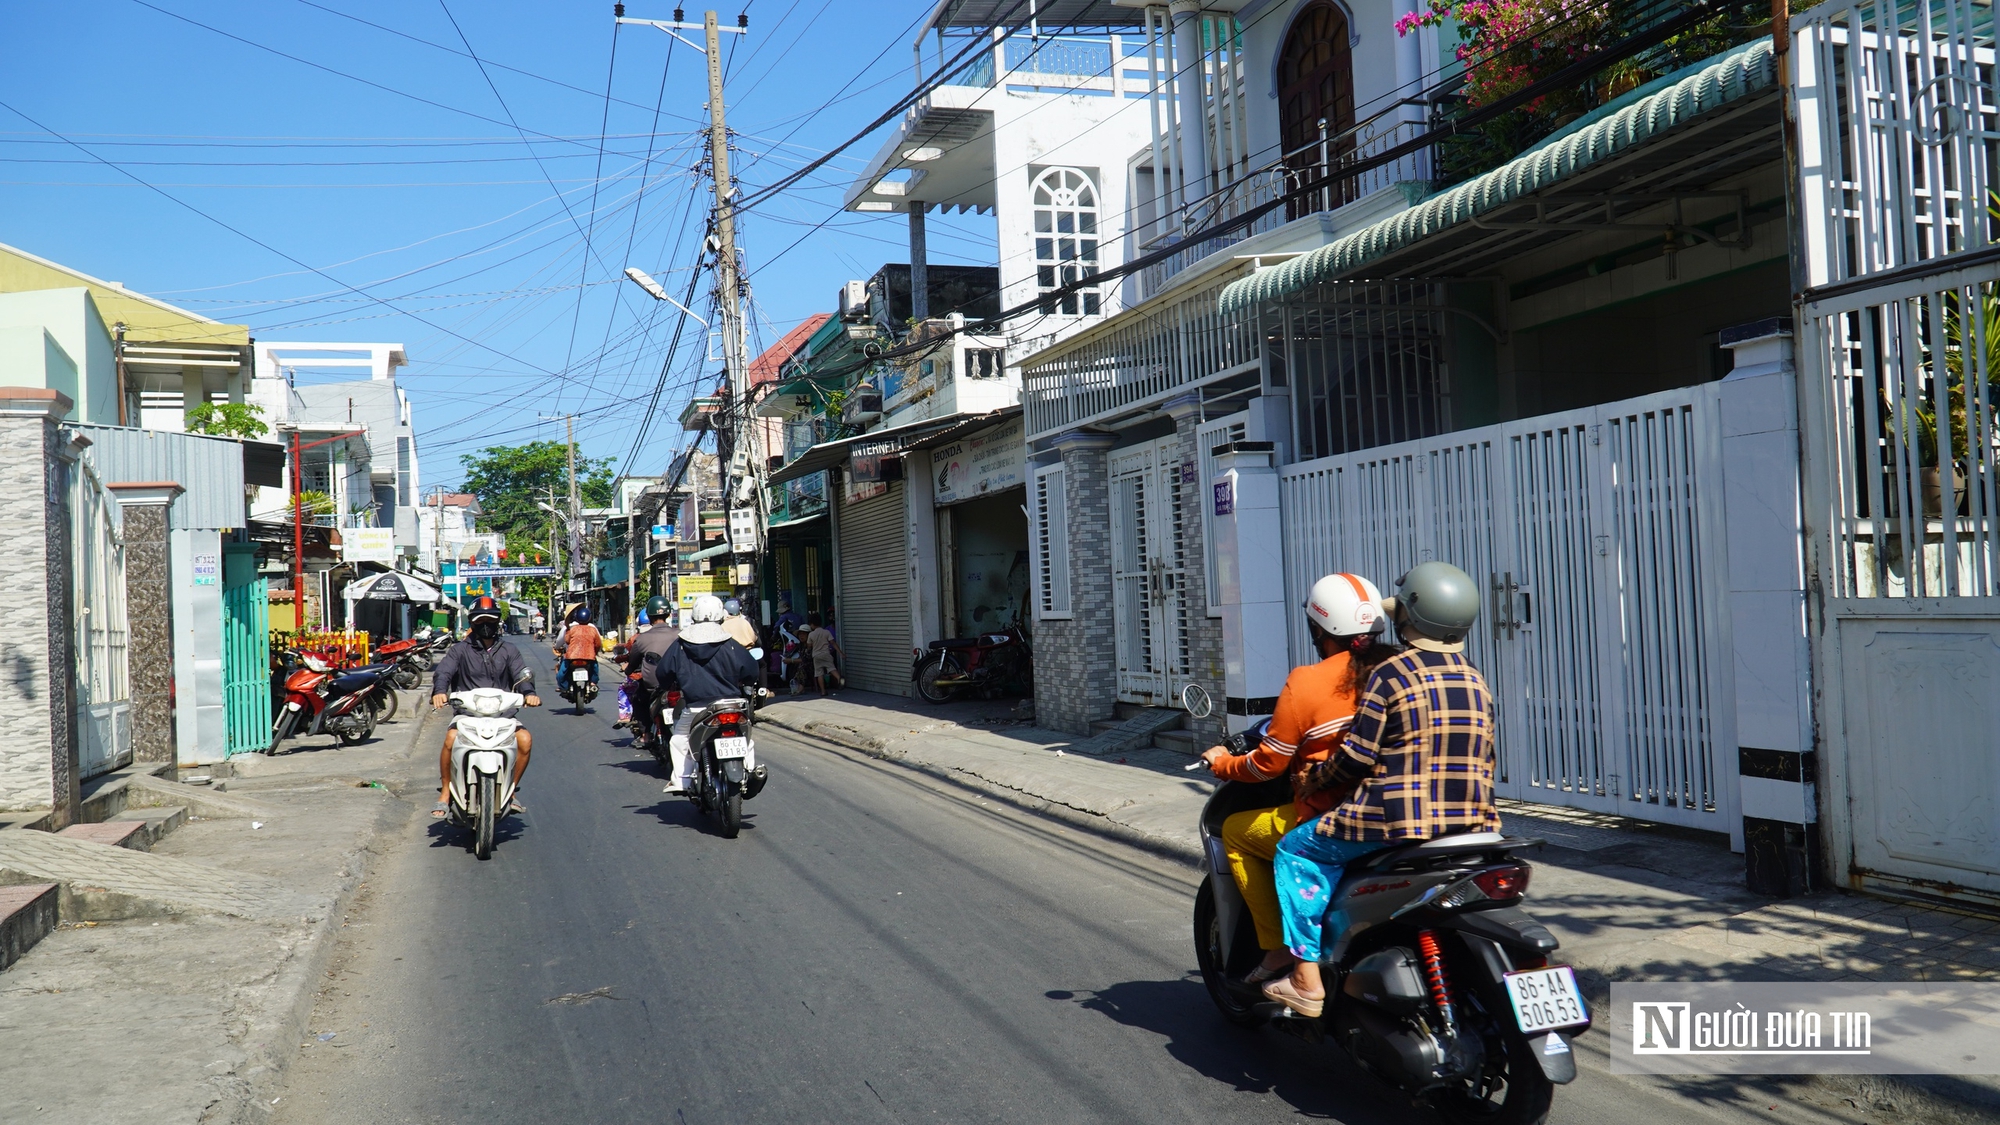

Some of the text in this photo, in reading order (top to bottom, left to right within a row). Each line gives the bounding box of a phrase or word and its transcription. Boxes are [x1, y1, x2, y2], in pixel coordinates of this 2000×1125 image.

[852, 440, 895, 457] INTERNET
[933, 443, 963, 463] HONDA
[1216, 485, 1230, 503] 39B
[1516, 971, 1568, 1000] 86-AA
[1519, 997, 1581, 1028] 506.53
